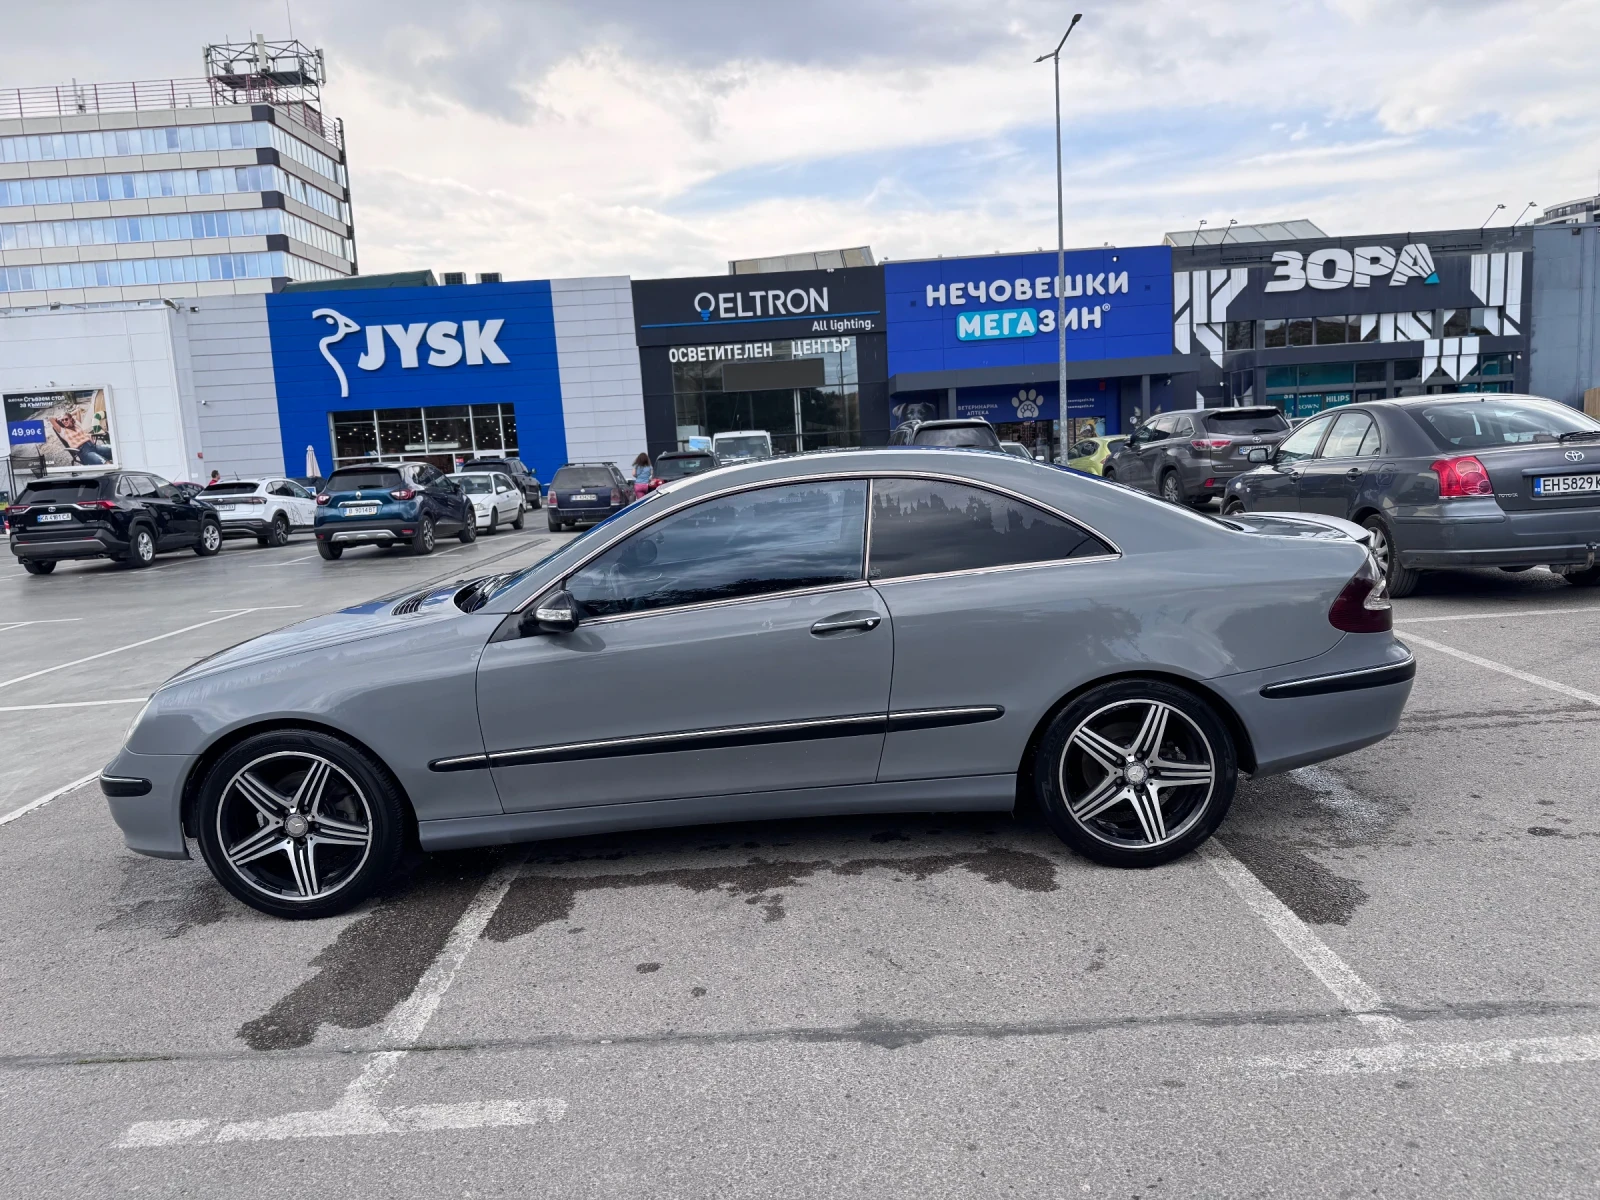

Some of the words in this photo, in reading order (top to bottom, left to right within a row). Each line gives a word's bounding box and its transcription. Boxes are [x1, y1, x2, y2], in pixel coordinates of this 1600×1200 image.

[1264, 243, 1440, 293] ЗОРА
[718, 287, 829, 318] ELTRON
[926, 271, 1129, 307] НЕЧОВЕШКИ
[812, 320, 828, 332] All
[830, 318, 875, 333] lighting.
[357, 318, 511, 371] JYSK
[668, 342, 773, 363] ОСВЕТИТЕЛЕН
[791, 338, 851, 357] ЦЕНТЪР
[11, 427, 36, 437] 49,99
[1543, 478, 1561, 492] EH
[1562, 476, 1594, 491] 5829
